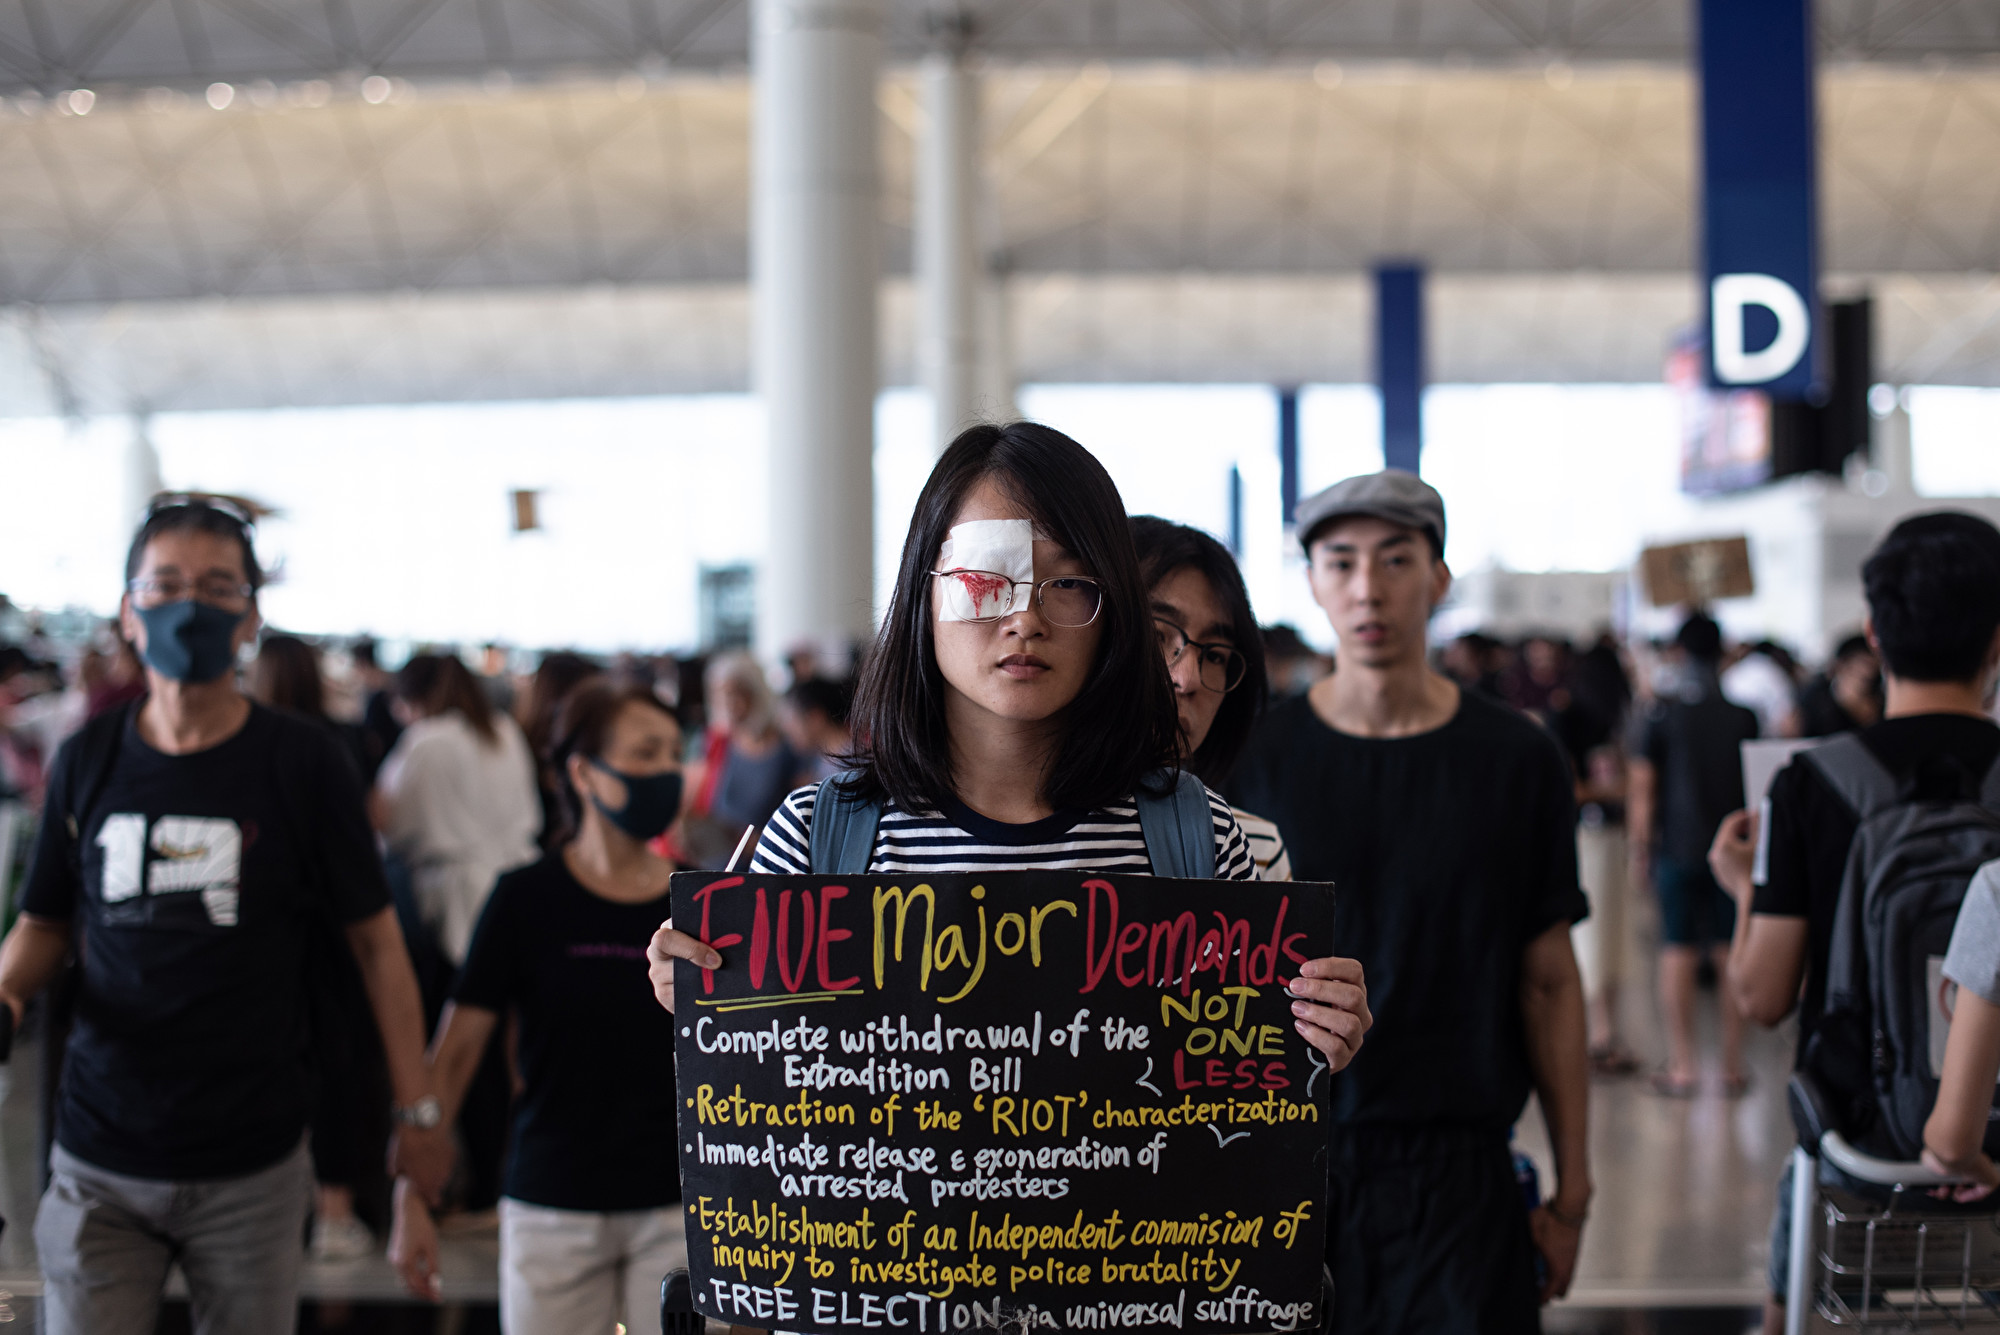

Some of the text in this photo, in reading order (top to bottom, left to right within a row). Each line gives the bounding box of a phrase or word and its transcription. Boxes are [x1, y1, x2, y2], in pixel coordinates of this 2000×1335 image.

[1711, 272, 1811, 385] D
[692, 876, 1308, 1003] FIVE Major Demands
[1161, 986, 1261, 1030] NOT
[696, 1008, 1150, 1063] Complete withdrawal of the
[1185, 1024, 1286, 1057] ONE
[784, 1053, 1022, 1095] Extradition Bill
[1173, 1048, 1292, 1091] LESS
[697, 1083, 855, 1127] Retraction
[870, 1093, 902, 1136] of
[913, 1100, 962, 1131] the
[1092, 1090, 1318, 1128] characterization
[697, 1131, 829, 1178] Immediate
[838, 1136, 938, 1175] release
[973, 1136, 1131, 1177] exoneration
[1136, 1131, 1168, 1175] of
[780, 1169, 1070, 1208] arrested protesters
[698, 1196, 1313, 1260] Establishment of an Independent commision of
[712, 1235, 1241, 1299] inquiry to investigate police brutality
[709, 1277, 800, 1322] FREE
[811, 1287, 1001, 1334] ELECTION
[1065, 1288, 1186, 1330] universal
[1194, 1285, 1313, 1332] suffrage
